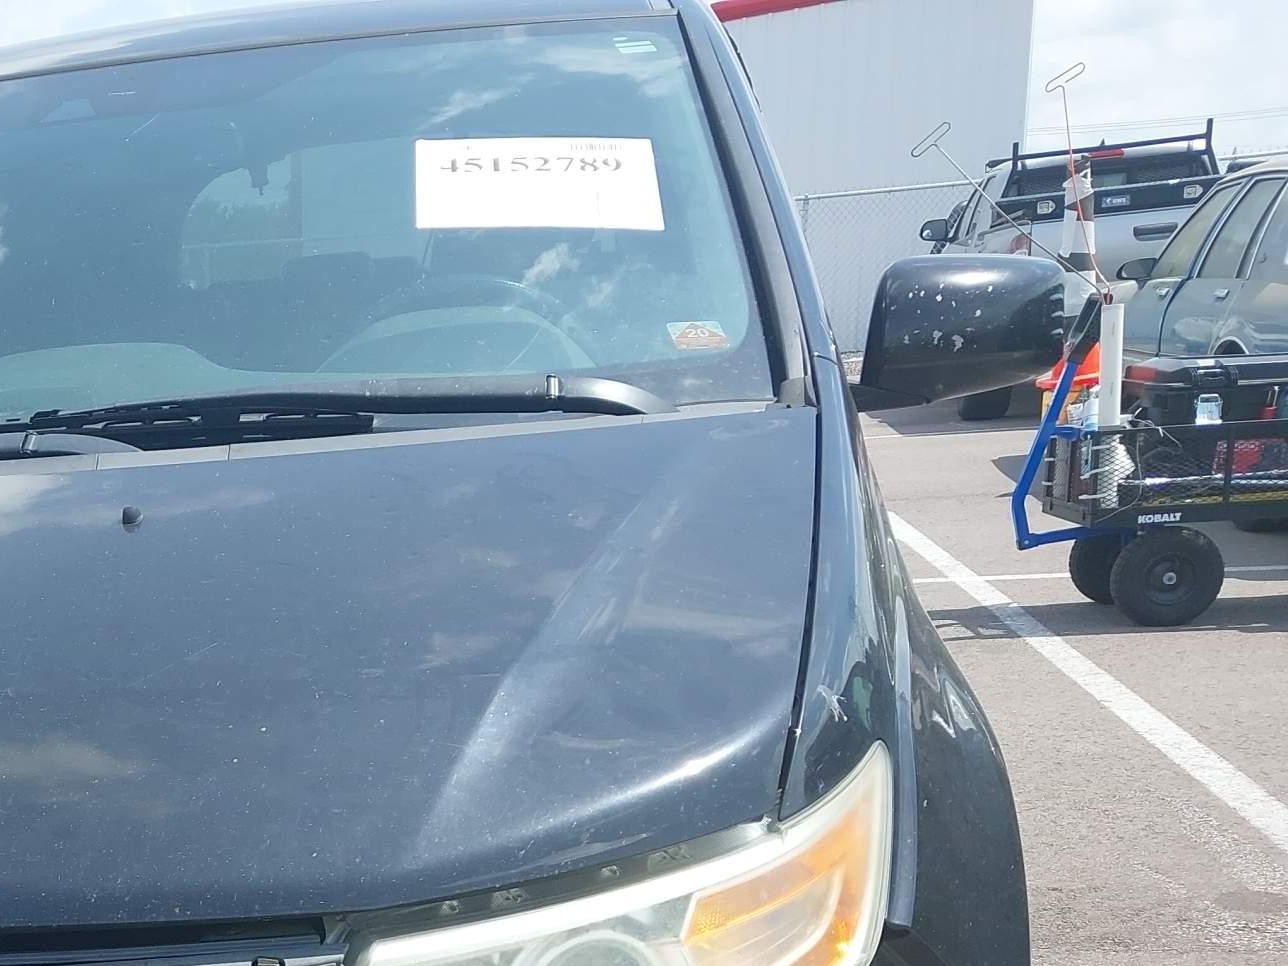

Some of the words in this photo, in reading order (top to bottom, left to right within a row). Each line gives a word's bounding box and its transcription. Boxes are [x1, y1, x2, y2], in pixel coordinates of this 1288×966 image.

[440, 156, 622, 173] 45152789
[685, 328, 709, 338] 20
[1137, 512, 1182, 524] KOBALT
